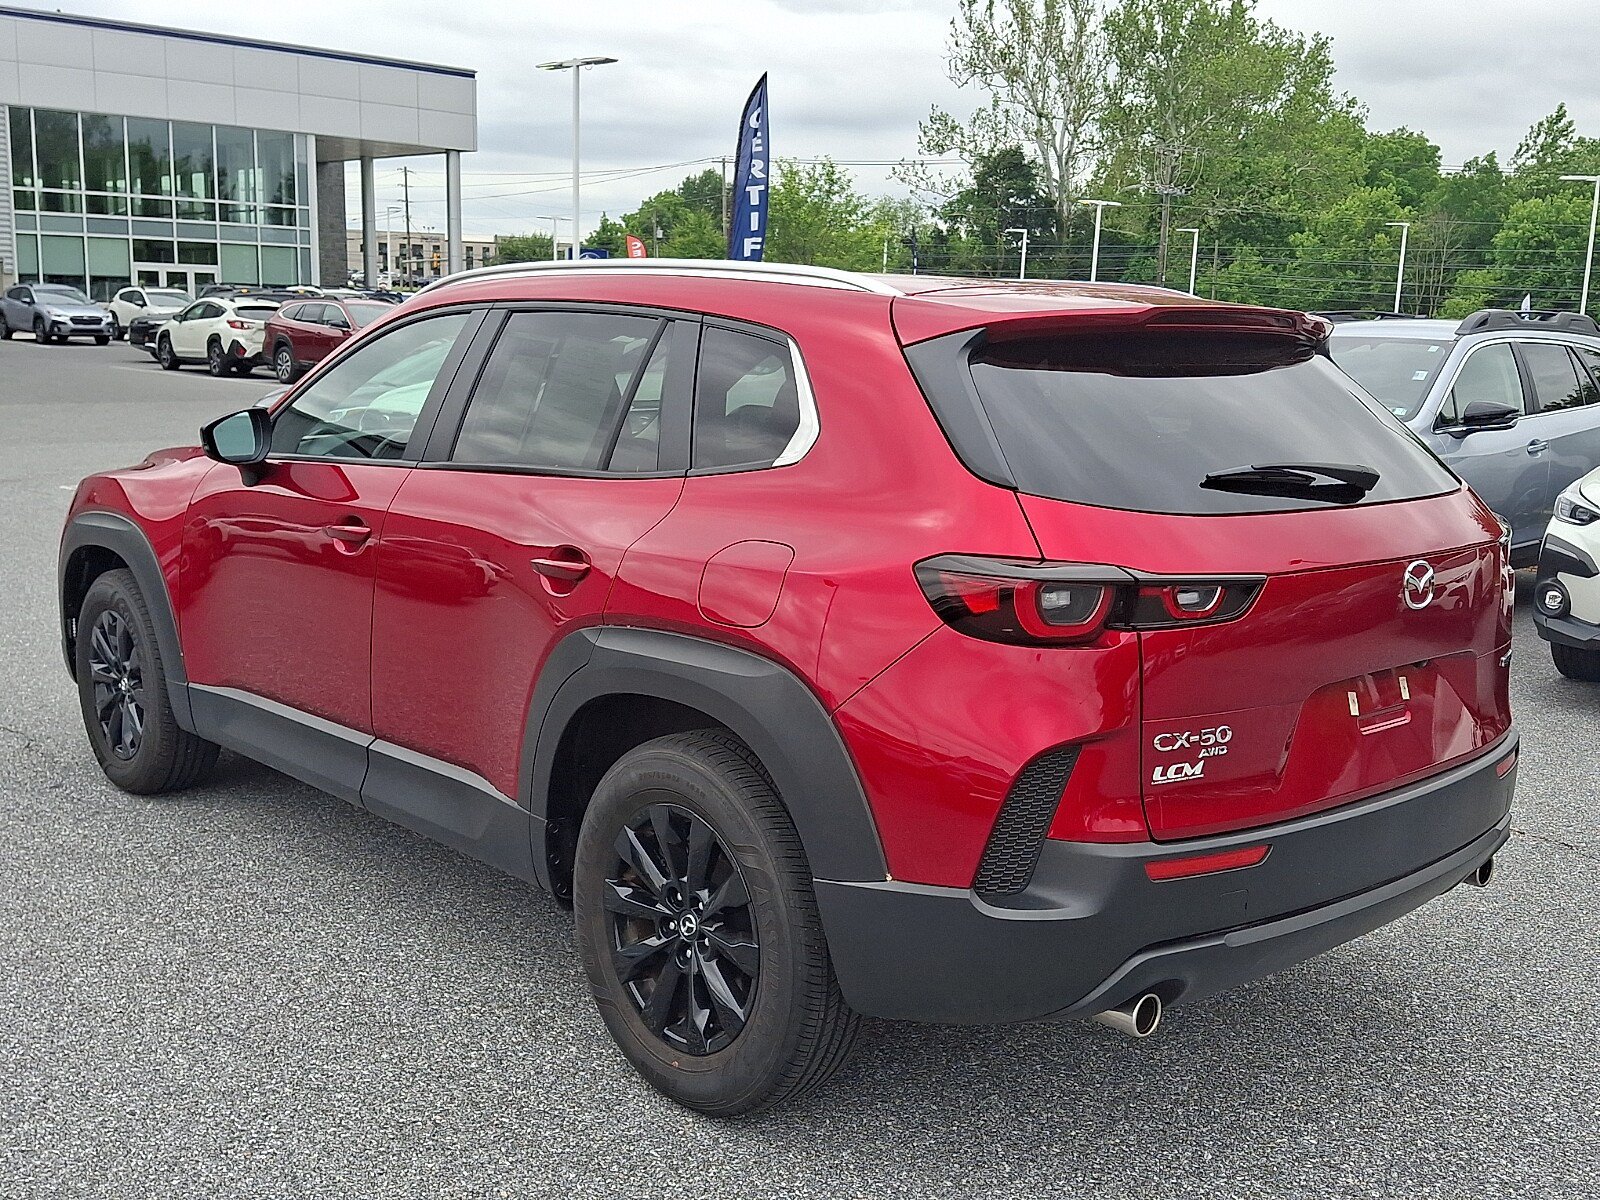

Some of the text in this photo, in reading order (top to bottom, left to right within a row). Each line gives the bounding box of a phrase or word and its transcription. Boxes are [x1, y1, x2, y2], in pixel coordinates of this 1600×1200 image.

[1153, 725, 1233, 752] CX-50
[1198, 745, 1228, 759] AWD
[1152, 760, 1205, 781] LCM
